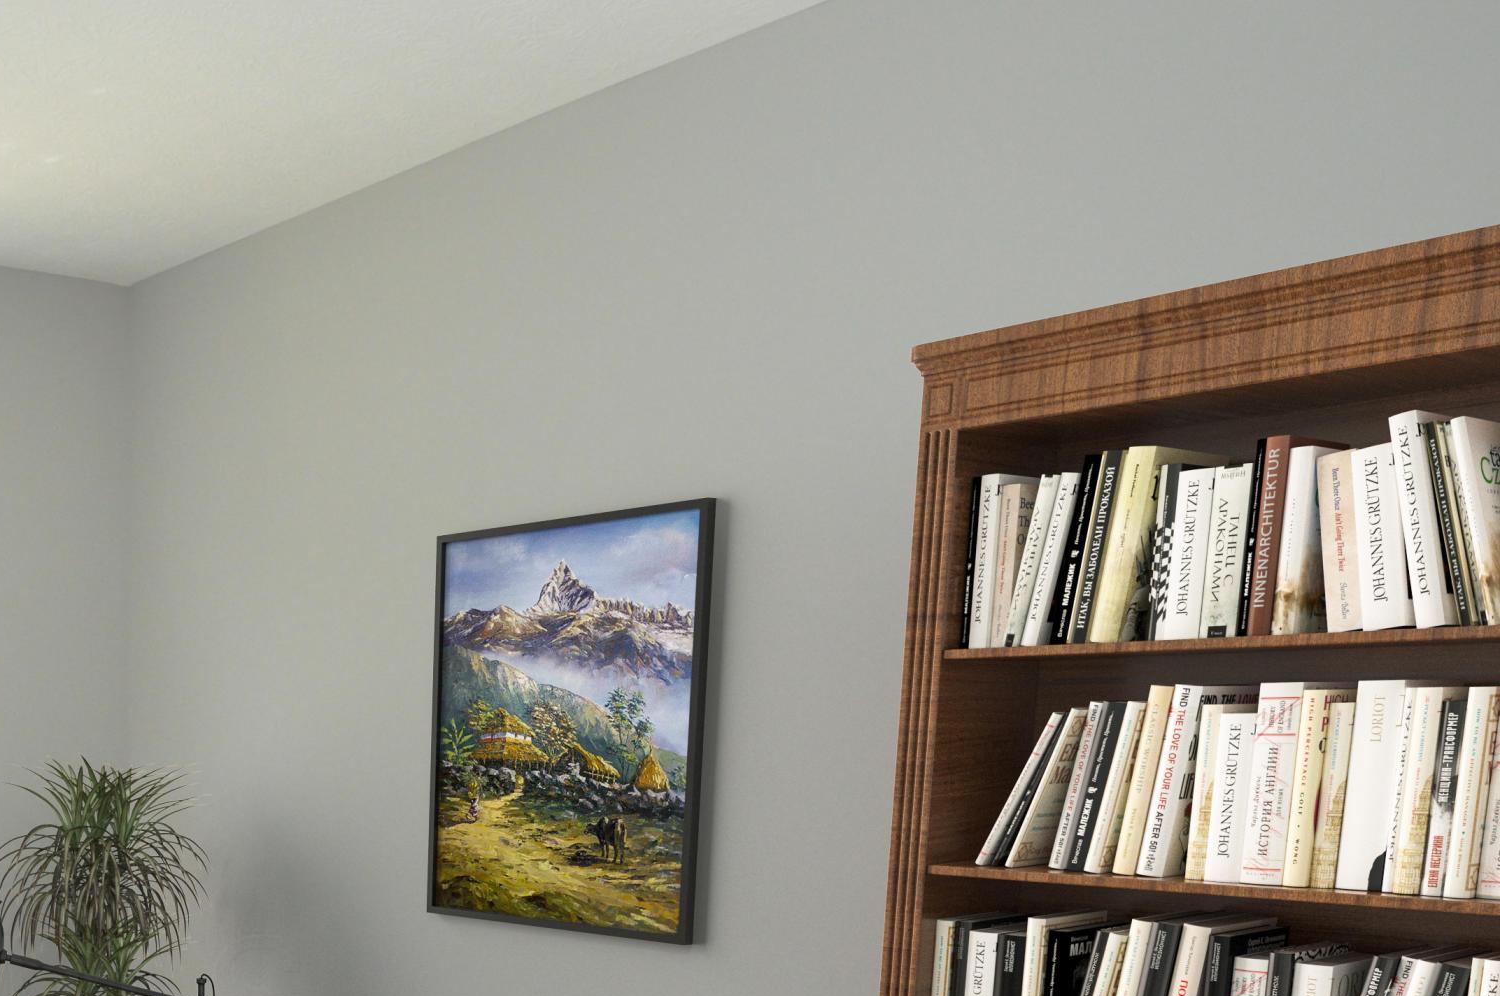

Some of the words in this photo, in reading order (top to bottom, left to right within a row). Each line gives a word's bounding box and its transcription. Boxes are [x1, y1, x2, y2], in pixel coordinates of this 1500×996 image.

[1098, 466, 1116, 524] ПРОКАЗОЙ
[1253, 448, 1281, 608] INNENARCHITEKTUR
[1086, 525, 1104, 580] ЗАБОЛЕЛИ
[1370, 527, 1388, 602] JOHANNES
[1410, 507, 1430, 596] JOHANNES
[1062, 563, 1076, 610] МАЛЕЖИК
[1083, 580, 1093, 597] ВЫ
[1176, 546, 1193, 615] JOHANNES
[1077, 597, 1091, 629] ИТАК,
[1179, 687, 1190, 708] FIND
[1090, 704, 1098, 722] FIND
[1175, 708, 1185, 725] THE
[1370, 697, 1386, 742] LORIOT
[1086, 722, 1094, 737] THE
[1171, 726, 1182, 752] LOVE
[1082, 740, 1090, 759] LOVE
[1168, 753, 1177, 764] OF
[1302, 726, 1312, 786] PERCENTAGE
[1438, 712, 1459, 803] ЖЕНЩИНА-ТРАНСФОРМЕР
[1072, 771, 1081, 796] YOUR
[1162, 764, 1174, 791] YOUR
[1265, 747, 1279, 795] АНГЛИИ
[1157, 791, 1167, 811] LIFE
[1077, 798, 1094, 837] МАЛЕЖИК
[1152, 811, 1164, 840] AFTER
[1217, 789, 1234, 858] JOHANNES
[1258, 800, 1274, 857] ИСТОРИЯ
[1292, 838, 1301, 865] WONG
[1432, 835, 1444, 868] НЕСТЕРИНА
[1428, 867, 1438, 889] ЕЛЕНА
[1404, 961, 1413, 978] FIND
[1398, 979, 1407, 996] THE
